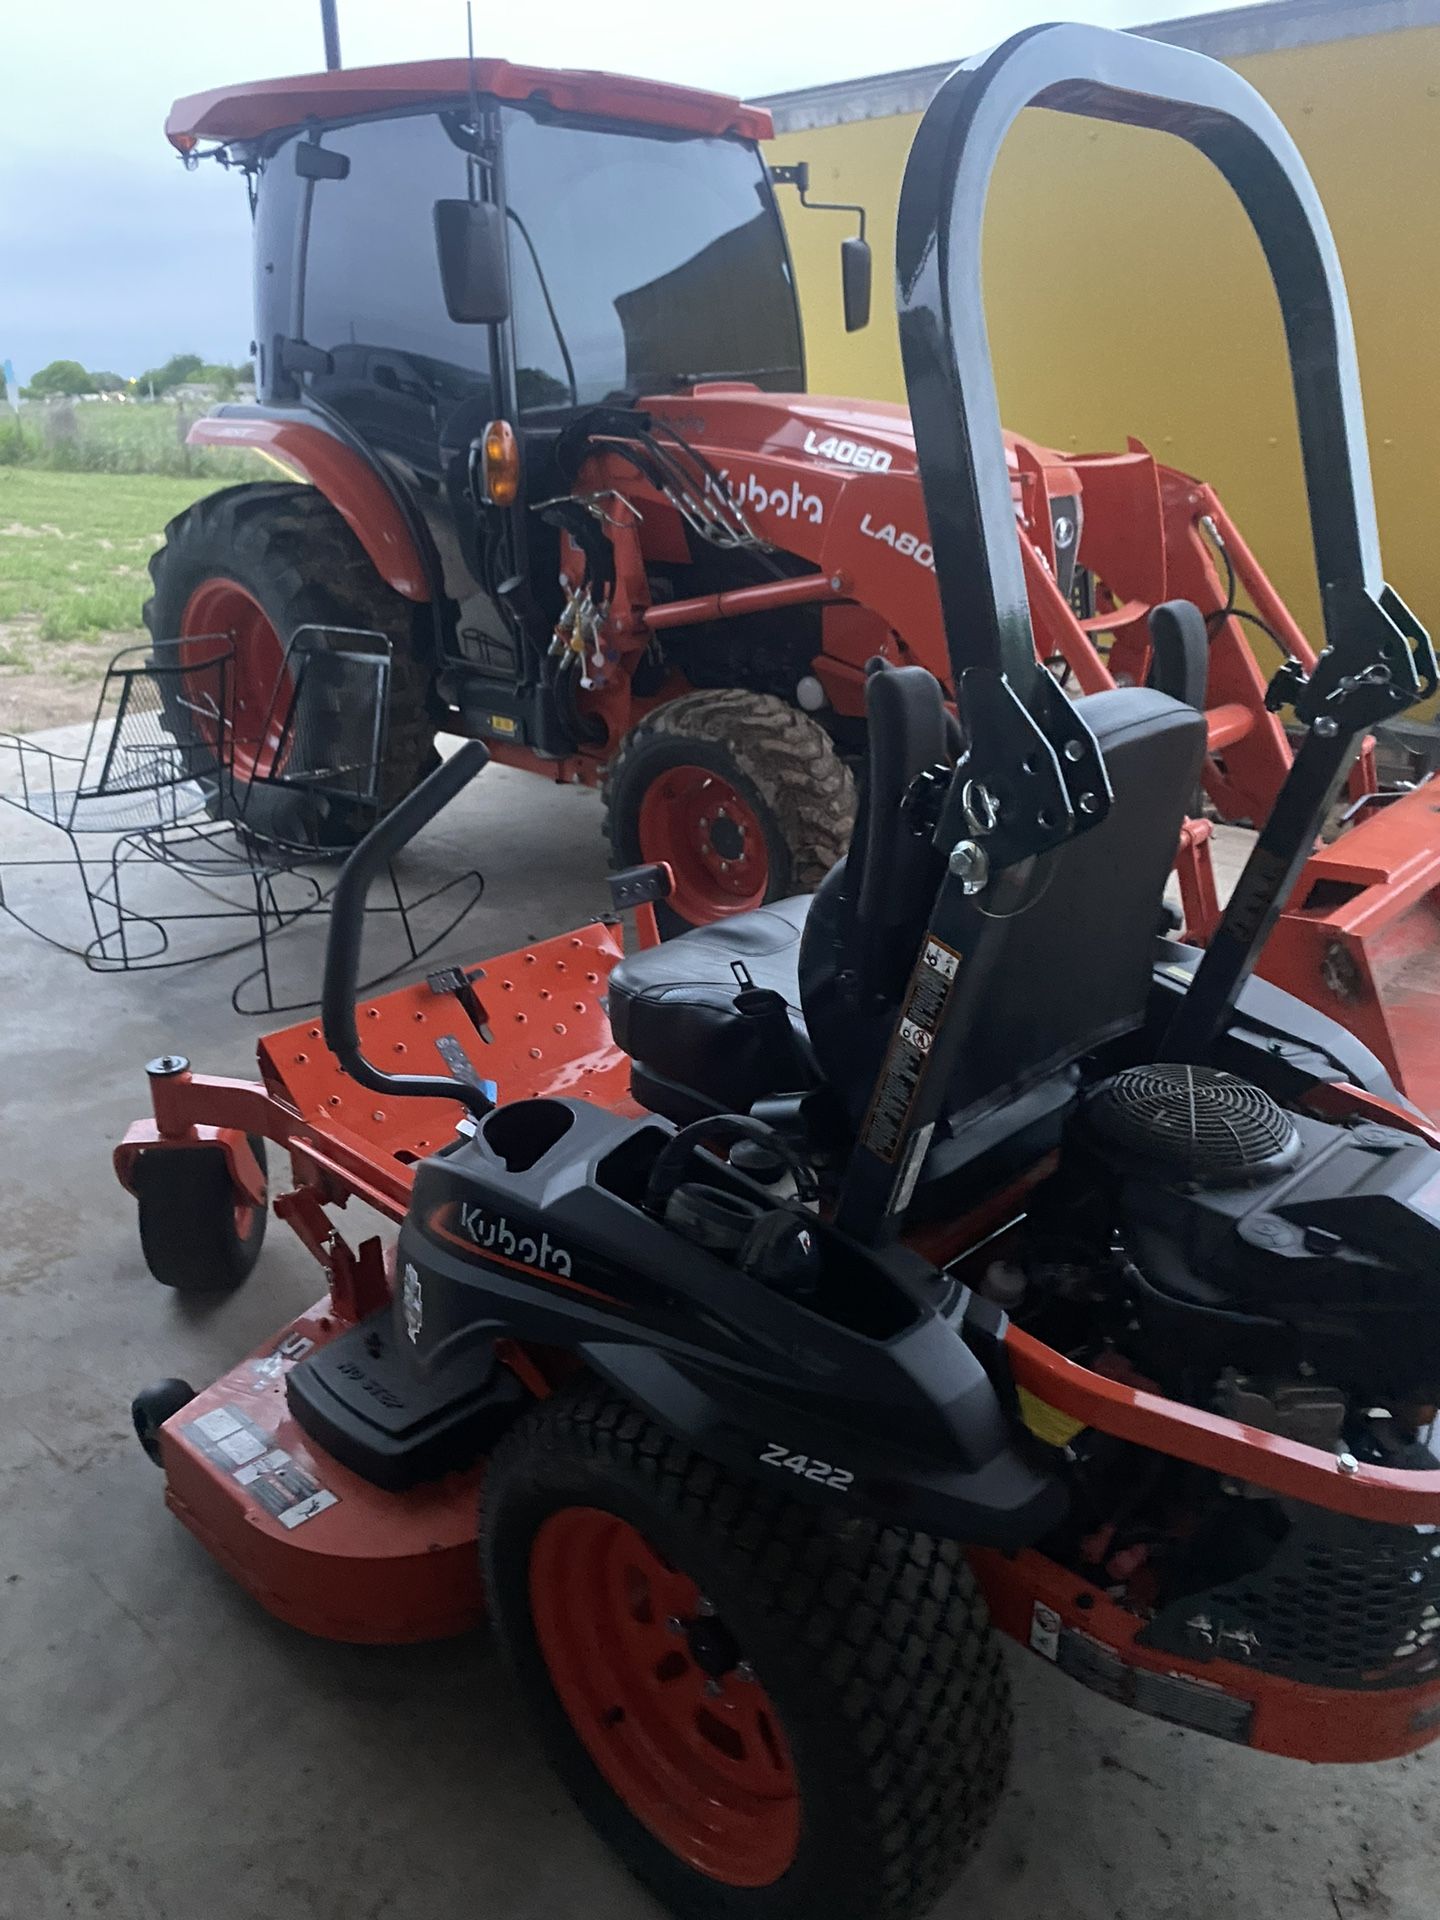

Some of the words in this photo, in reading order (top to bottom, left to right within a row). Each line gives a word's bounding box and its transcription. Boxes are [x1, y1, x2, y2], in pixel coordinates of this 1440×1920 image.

[803, 430, 892, 472] L4060
[859, 513, 937, 573] LA80
[460, 1201, 573, 1278] Kubota
[759, 1442, 855, 1492] Z422
